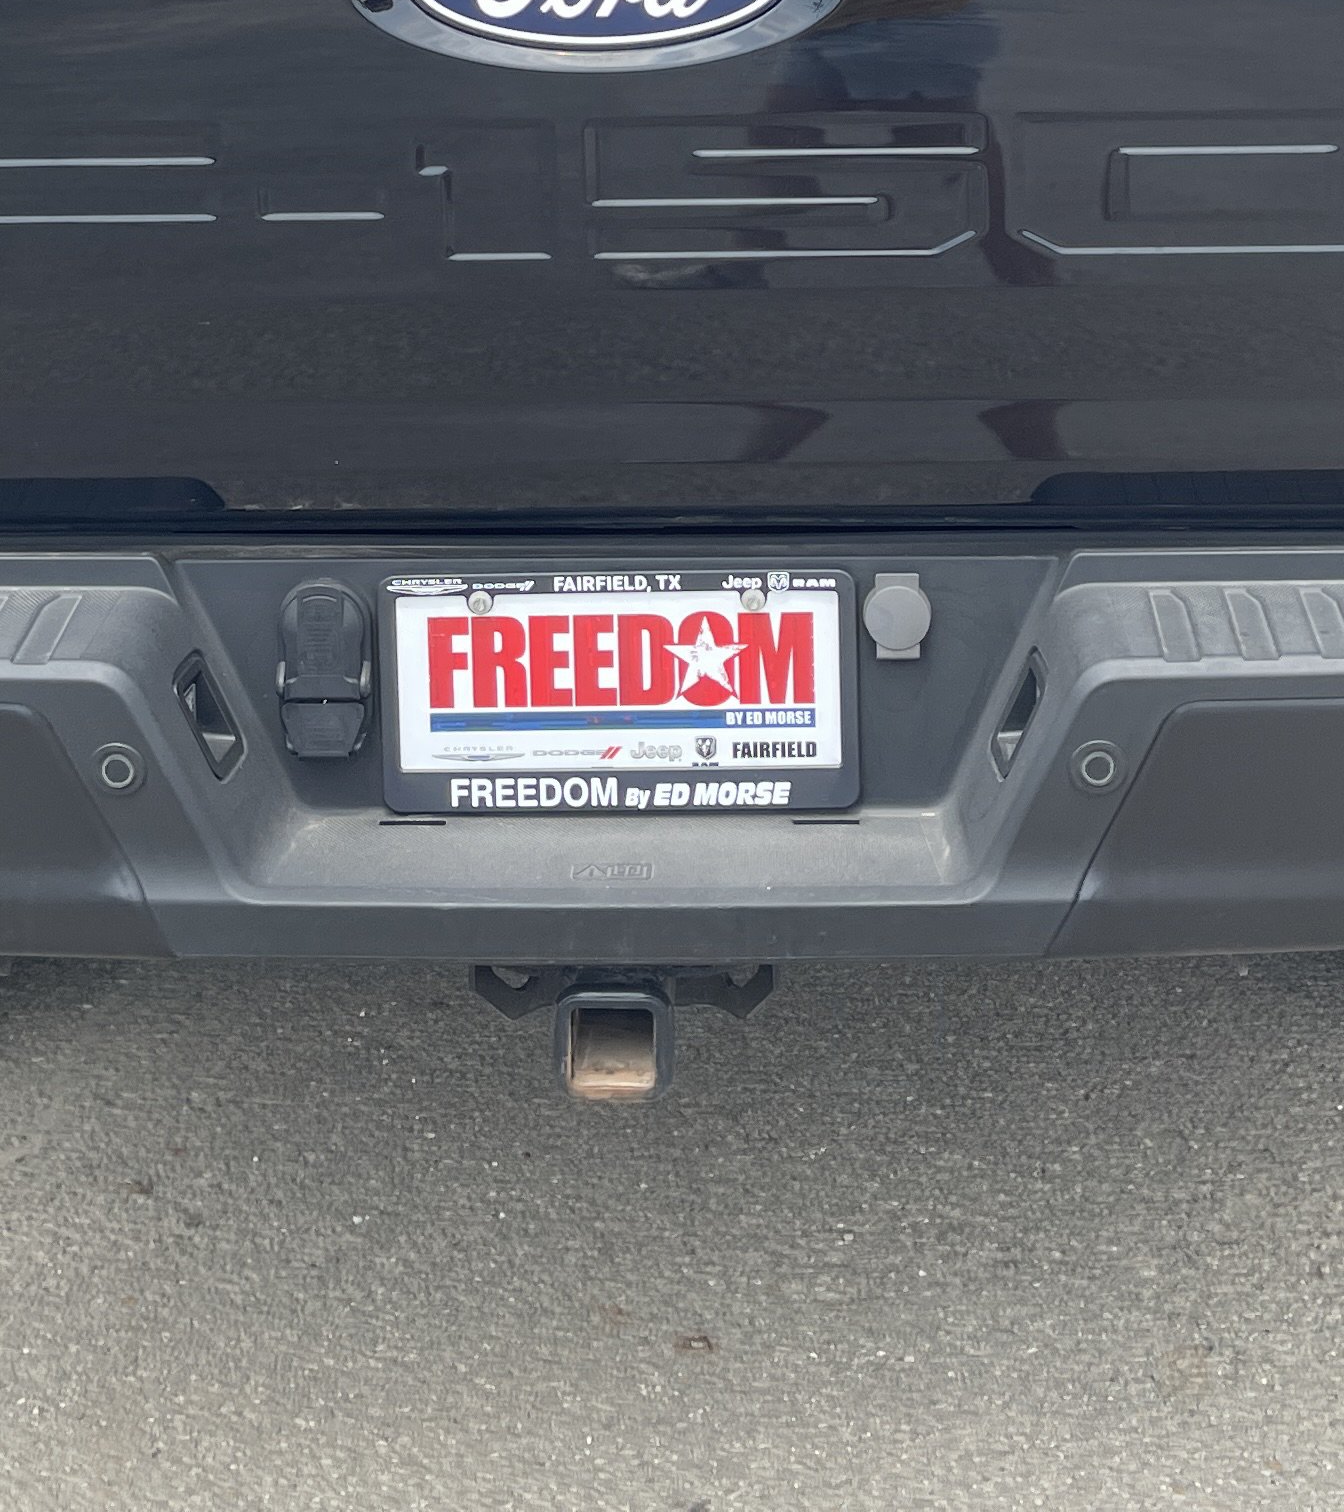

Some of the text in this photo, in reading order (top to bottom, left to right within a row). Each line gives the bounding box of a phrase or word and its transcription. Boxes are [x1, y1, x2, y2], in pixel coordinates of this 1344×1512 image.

[391, 578, 463, 586] CHRYSLER
[553, 574, 681, 592] FAIRFIELD, TX
[721, 574, 762, 589] Jeep
[792, 578, 836, 587] RAM
[427, 610, 815, 709] FREEDOM
[726, 710, 812, 725] BY ED MORSE
[443, 745, 514, 753] CHRYSLER
[630, 741, 683, 762] Jeep
[732, 741, 817, 759] FAIRFIELD
[450, 776, 792, 810] FREEDOM By ED MORSE
